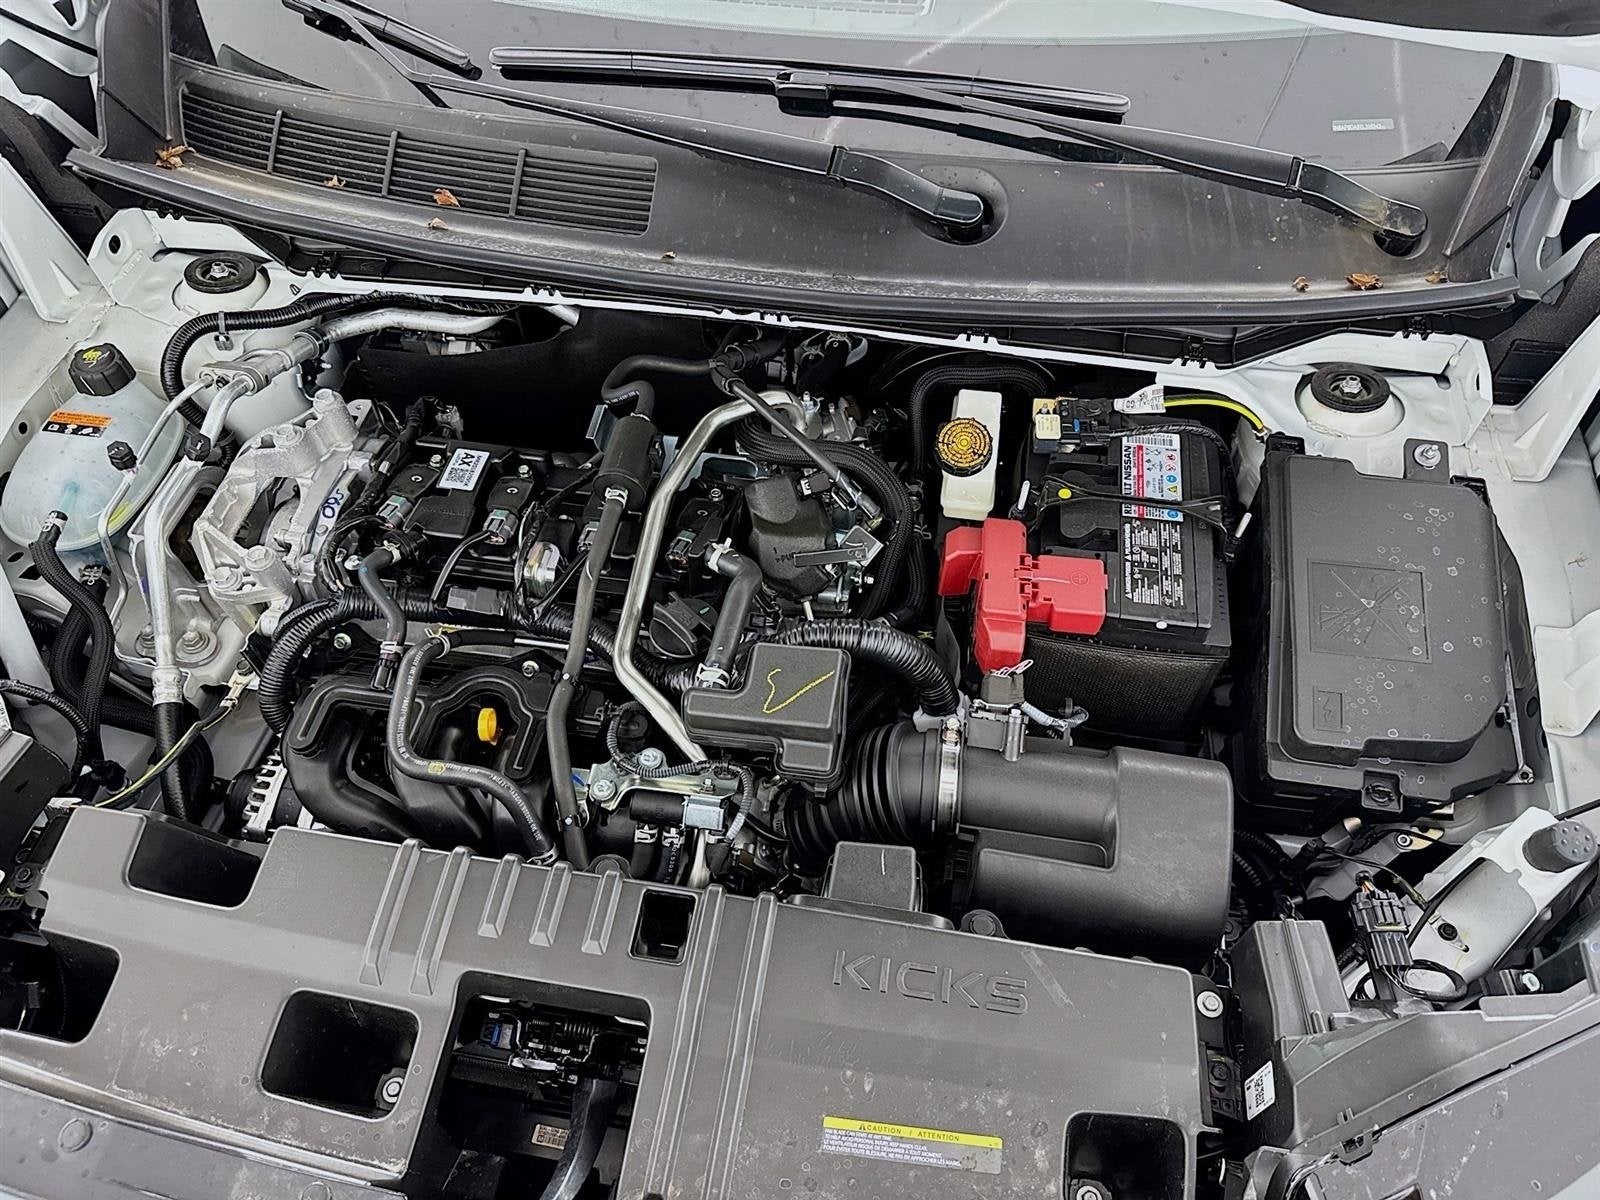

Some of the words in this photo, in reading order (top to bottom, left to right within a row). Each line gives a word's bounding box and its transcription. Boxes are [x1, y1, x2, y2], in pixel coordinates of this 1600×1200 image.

[459, 452, 476, 467] AX
[1123, 446, 1132, 481] NISSAN
[833, 950, 1028, 1015] KICKS
[866, 1124, 902, 1135] CAUTION
[917, 1131, 960, 1142] ATTENTION
